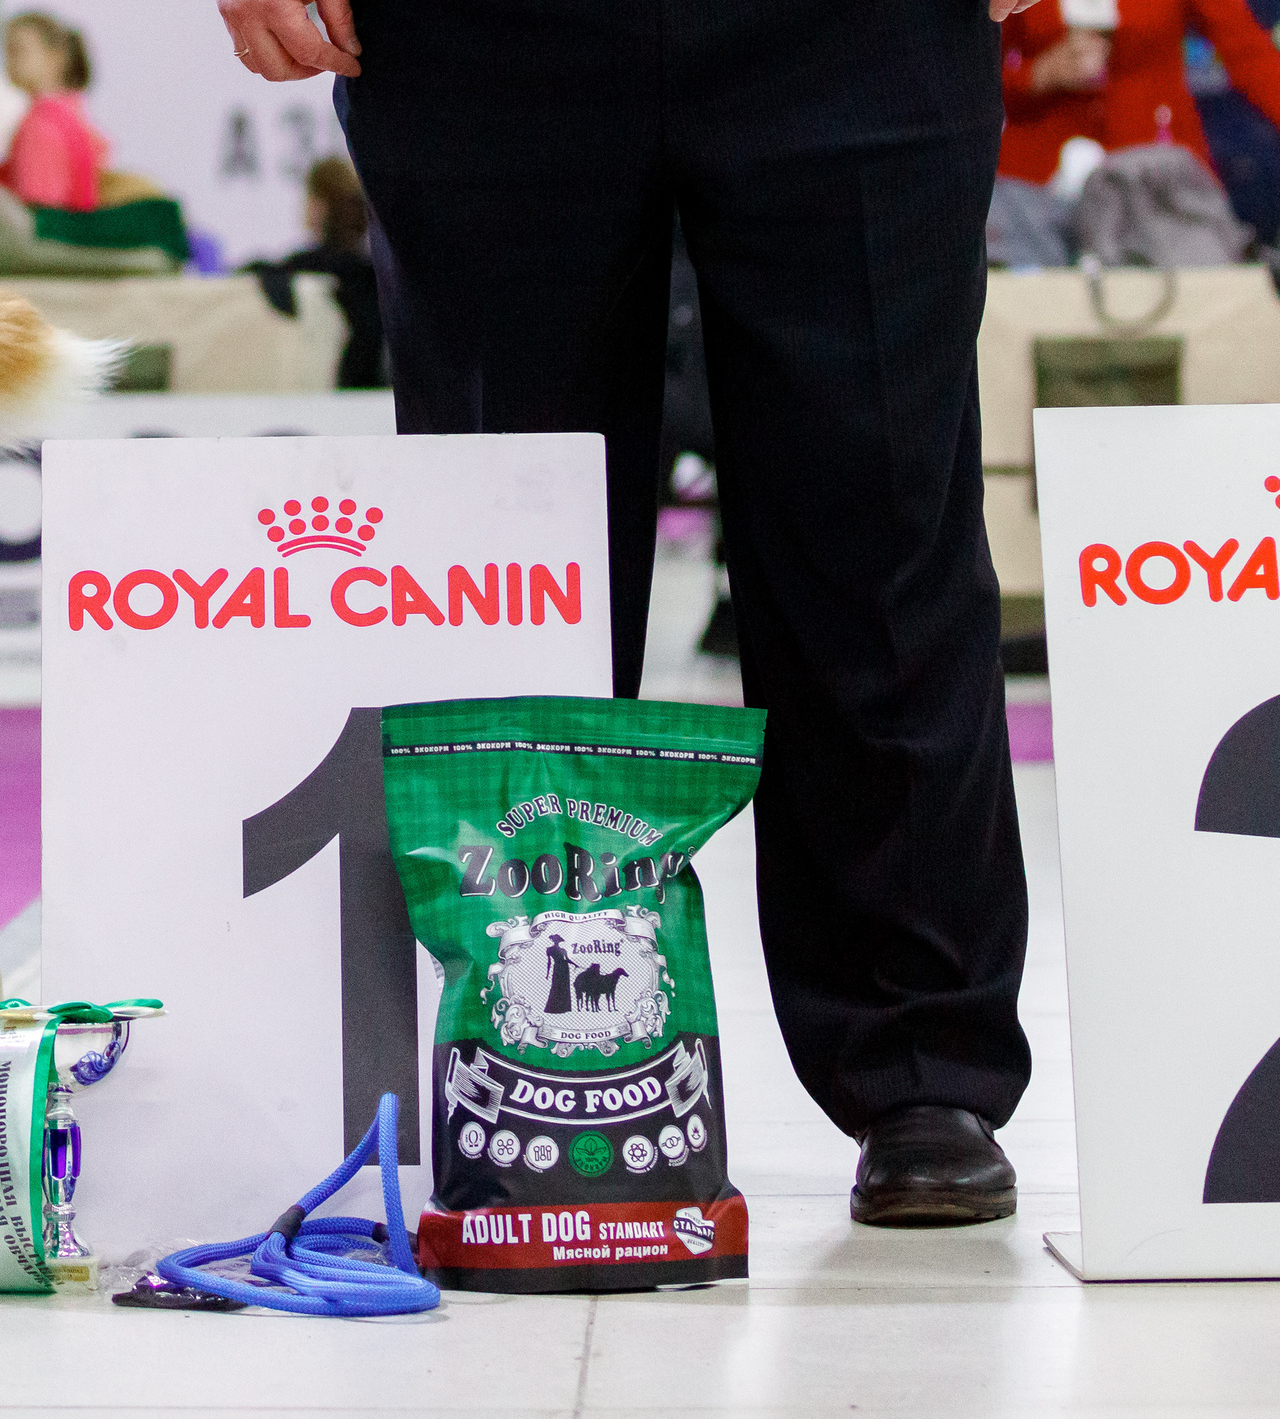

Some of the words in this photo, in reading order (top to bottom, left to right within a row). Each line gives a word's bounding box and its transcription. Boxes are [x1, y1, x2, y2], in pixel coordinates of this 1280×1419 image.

[1078, 536, 1280, 608] ROYA
[68, 566, 311, 631] ROYAL
[330, 561, 582, 627] CANIN
[496, 793, 562, 838] SUPER
[566, 798, 663, 847] PREMIUM
[568, 911, 608, 921] QUALITY
[242, 707, 421, 1166] 1
[561, 1032, 581, 1040] DOG
[585, 1030, 611, 1039] FOOD
[509, 1079, 577, 1112] DOG
[584, 1076, 662, 1113] FOOD
[462, 1213, 532, 1244] ADULT
[541, 1210, 591, 1243] DOG
[598, 1220, 665, 1240] STANDART
[552, 1245, 611, 1261] Мясной
[615, 1244, 669, 1260] рацион
